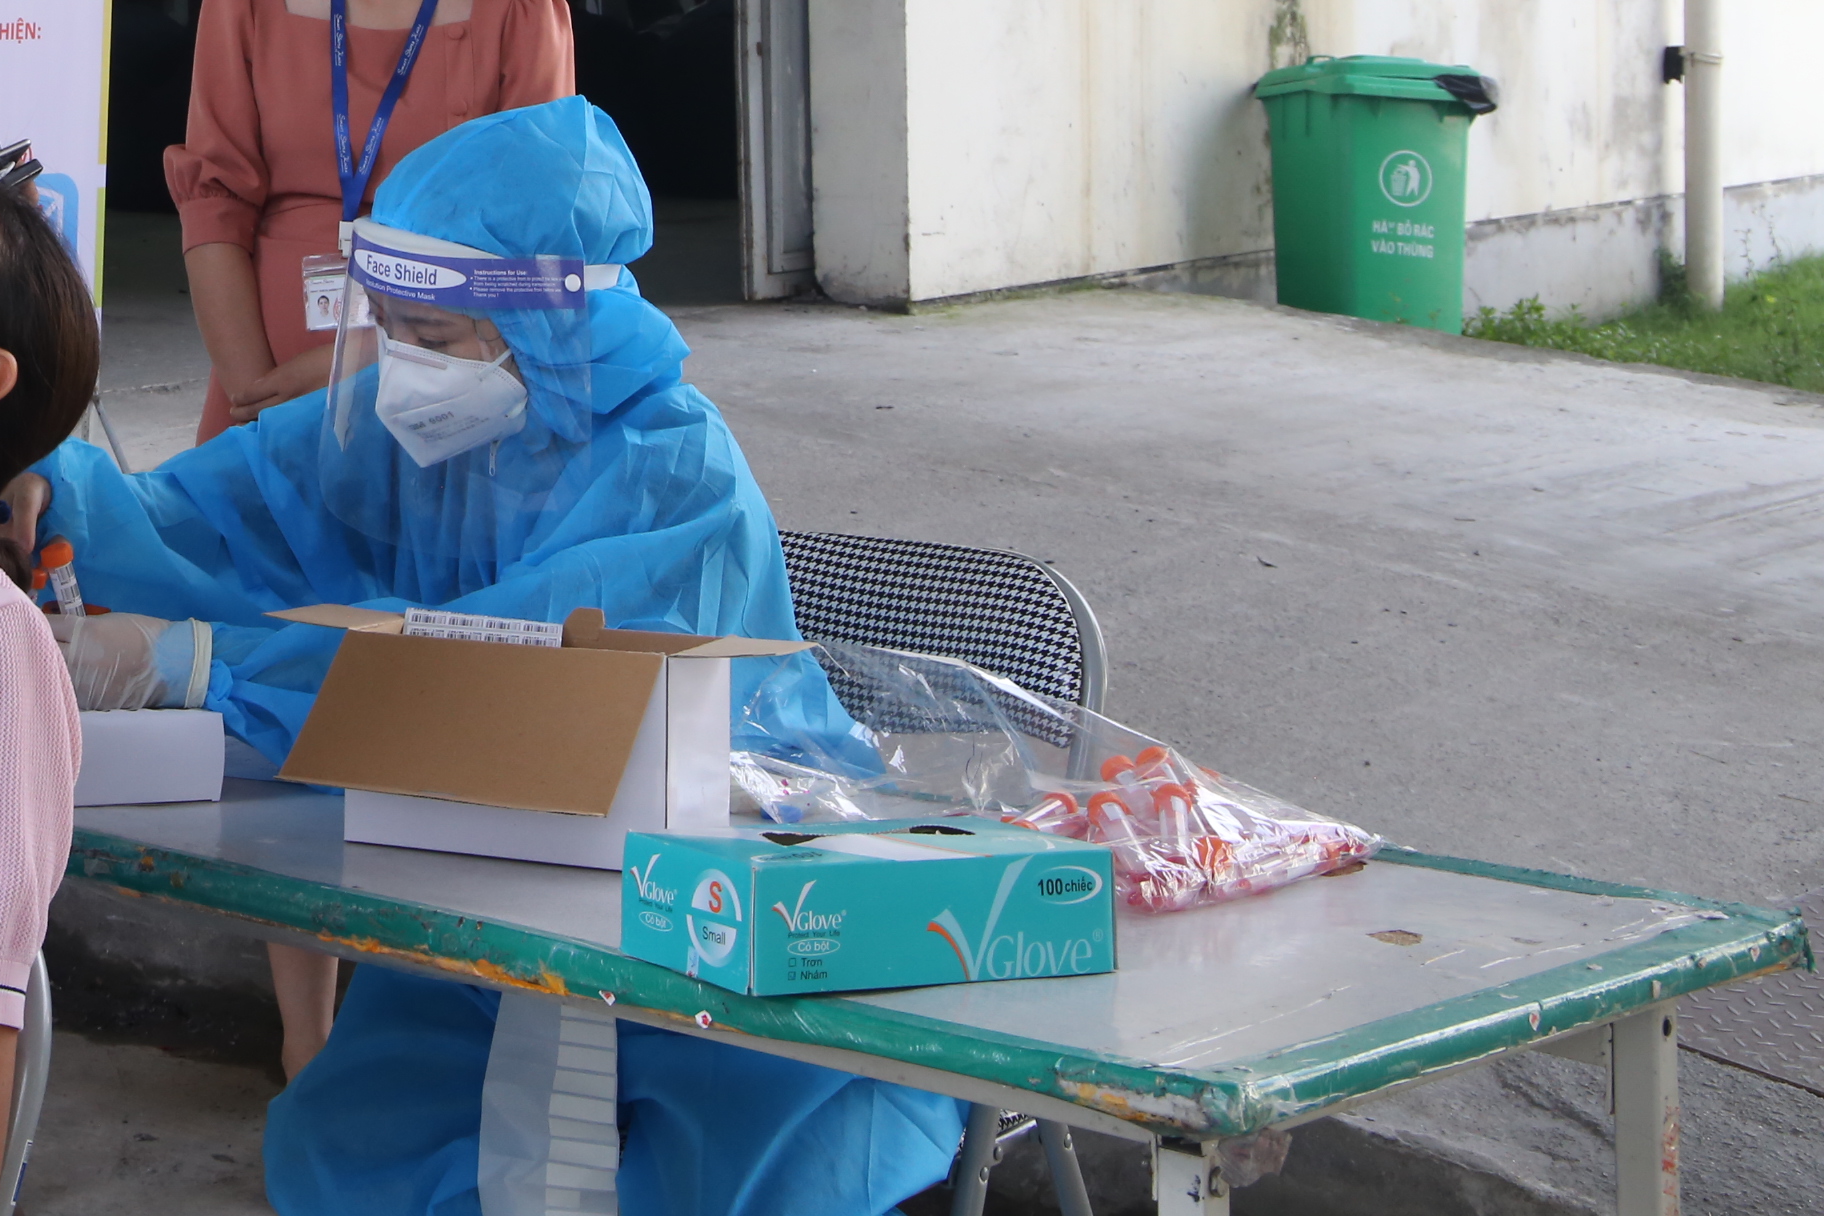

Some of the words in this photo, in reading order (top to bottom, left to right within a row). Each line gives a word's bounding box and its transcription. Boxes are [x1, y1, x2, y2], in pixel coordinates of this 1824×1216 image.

[366, 254, 391, 277] Face
[394, 263, 437, 285] Shield
[386, 285, 416, 298] Protective
[417, 291, 436, 301] Mask
[1037, 878, 1063, 896] 100
[1065, 876, 1093, 892] chiếc
[709, 881, 722, 913] S
[702, 926, 726, 945] Small
[798, 941, 811, 952] Có
[814, 941, 830, 952] bột
[801, 958, 823, 967] Trơn
[800, 970, 828, 980] Nhám
